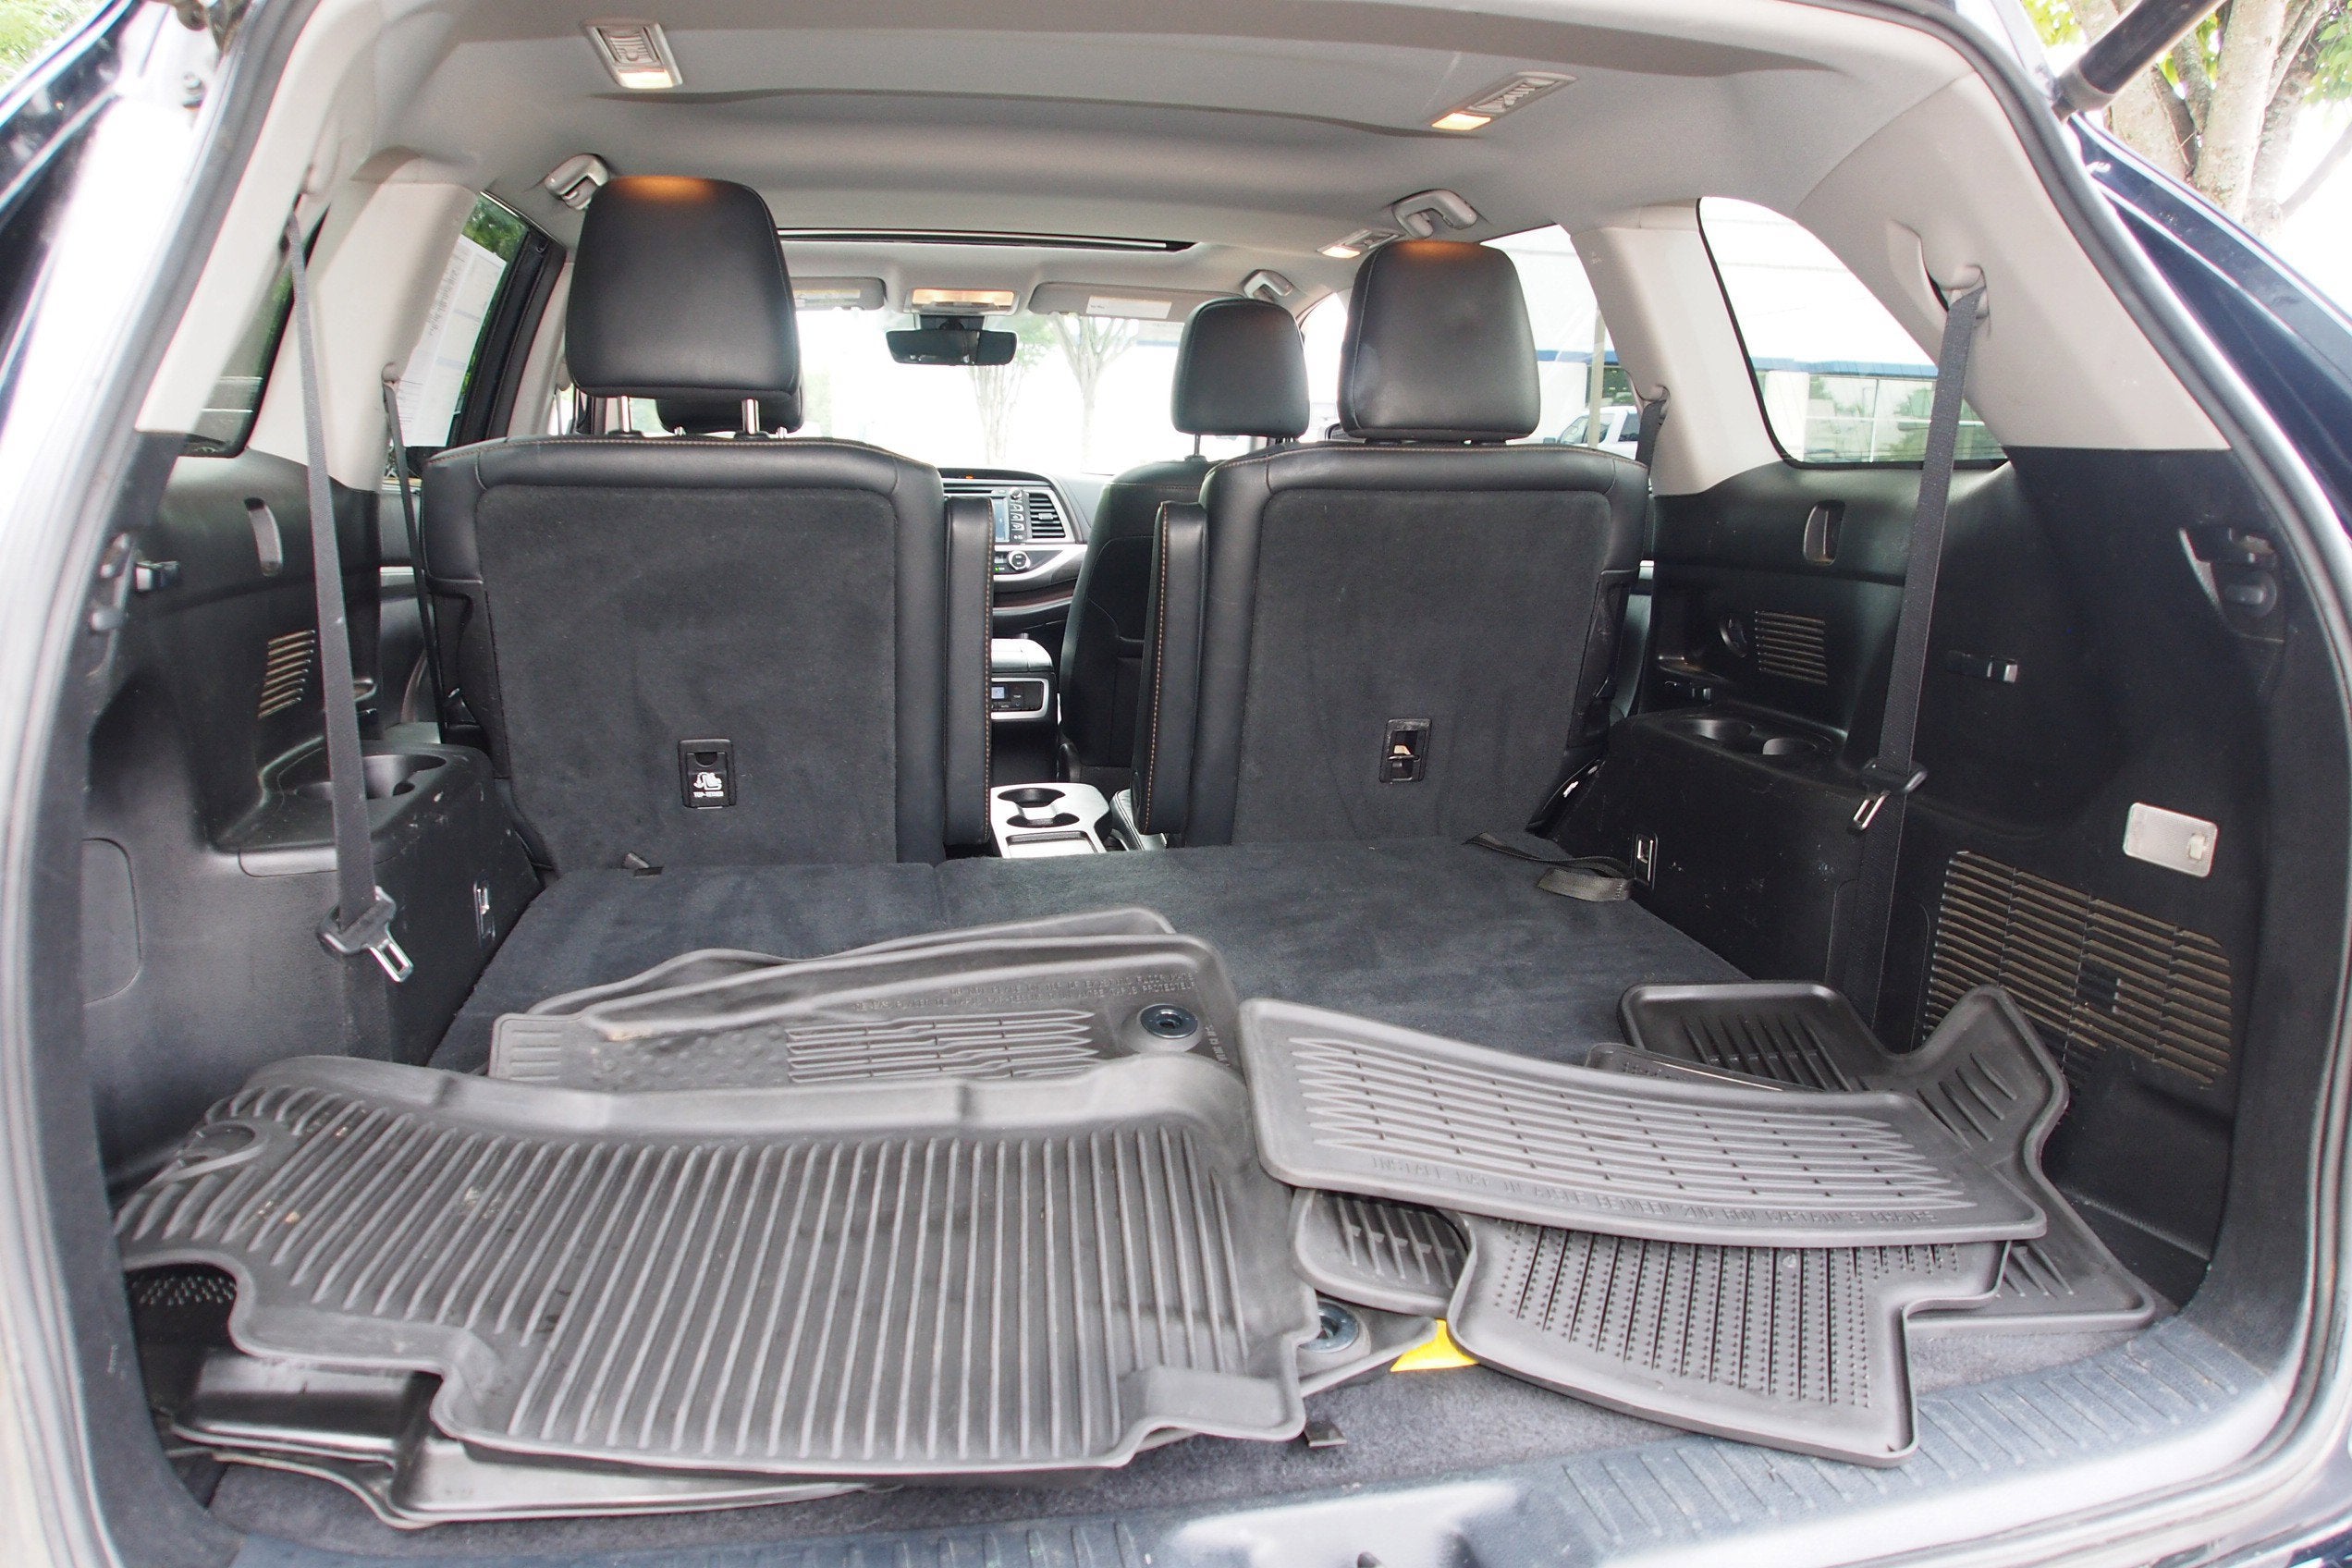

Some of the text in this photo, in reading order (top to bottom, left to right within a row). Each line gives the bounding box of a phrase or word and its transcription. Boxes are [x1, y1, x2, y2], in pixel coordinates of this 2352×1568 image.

[1371, 1157, 1442, 1180] INSTALL
[1595, 1194, 1673, 1216] BETWEEN
[1722, 1207, 1756, 1222] ROW
[1872, 1210, 1939, 1224] CHAIRS
